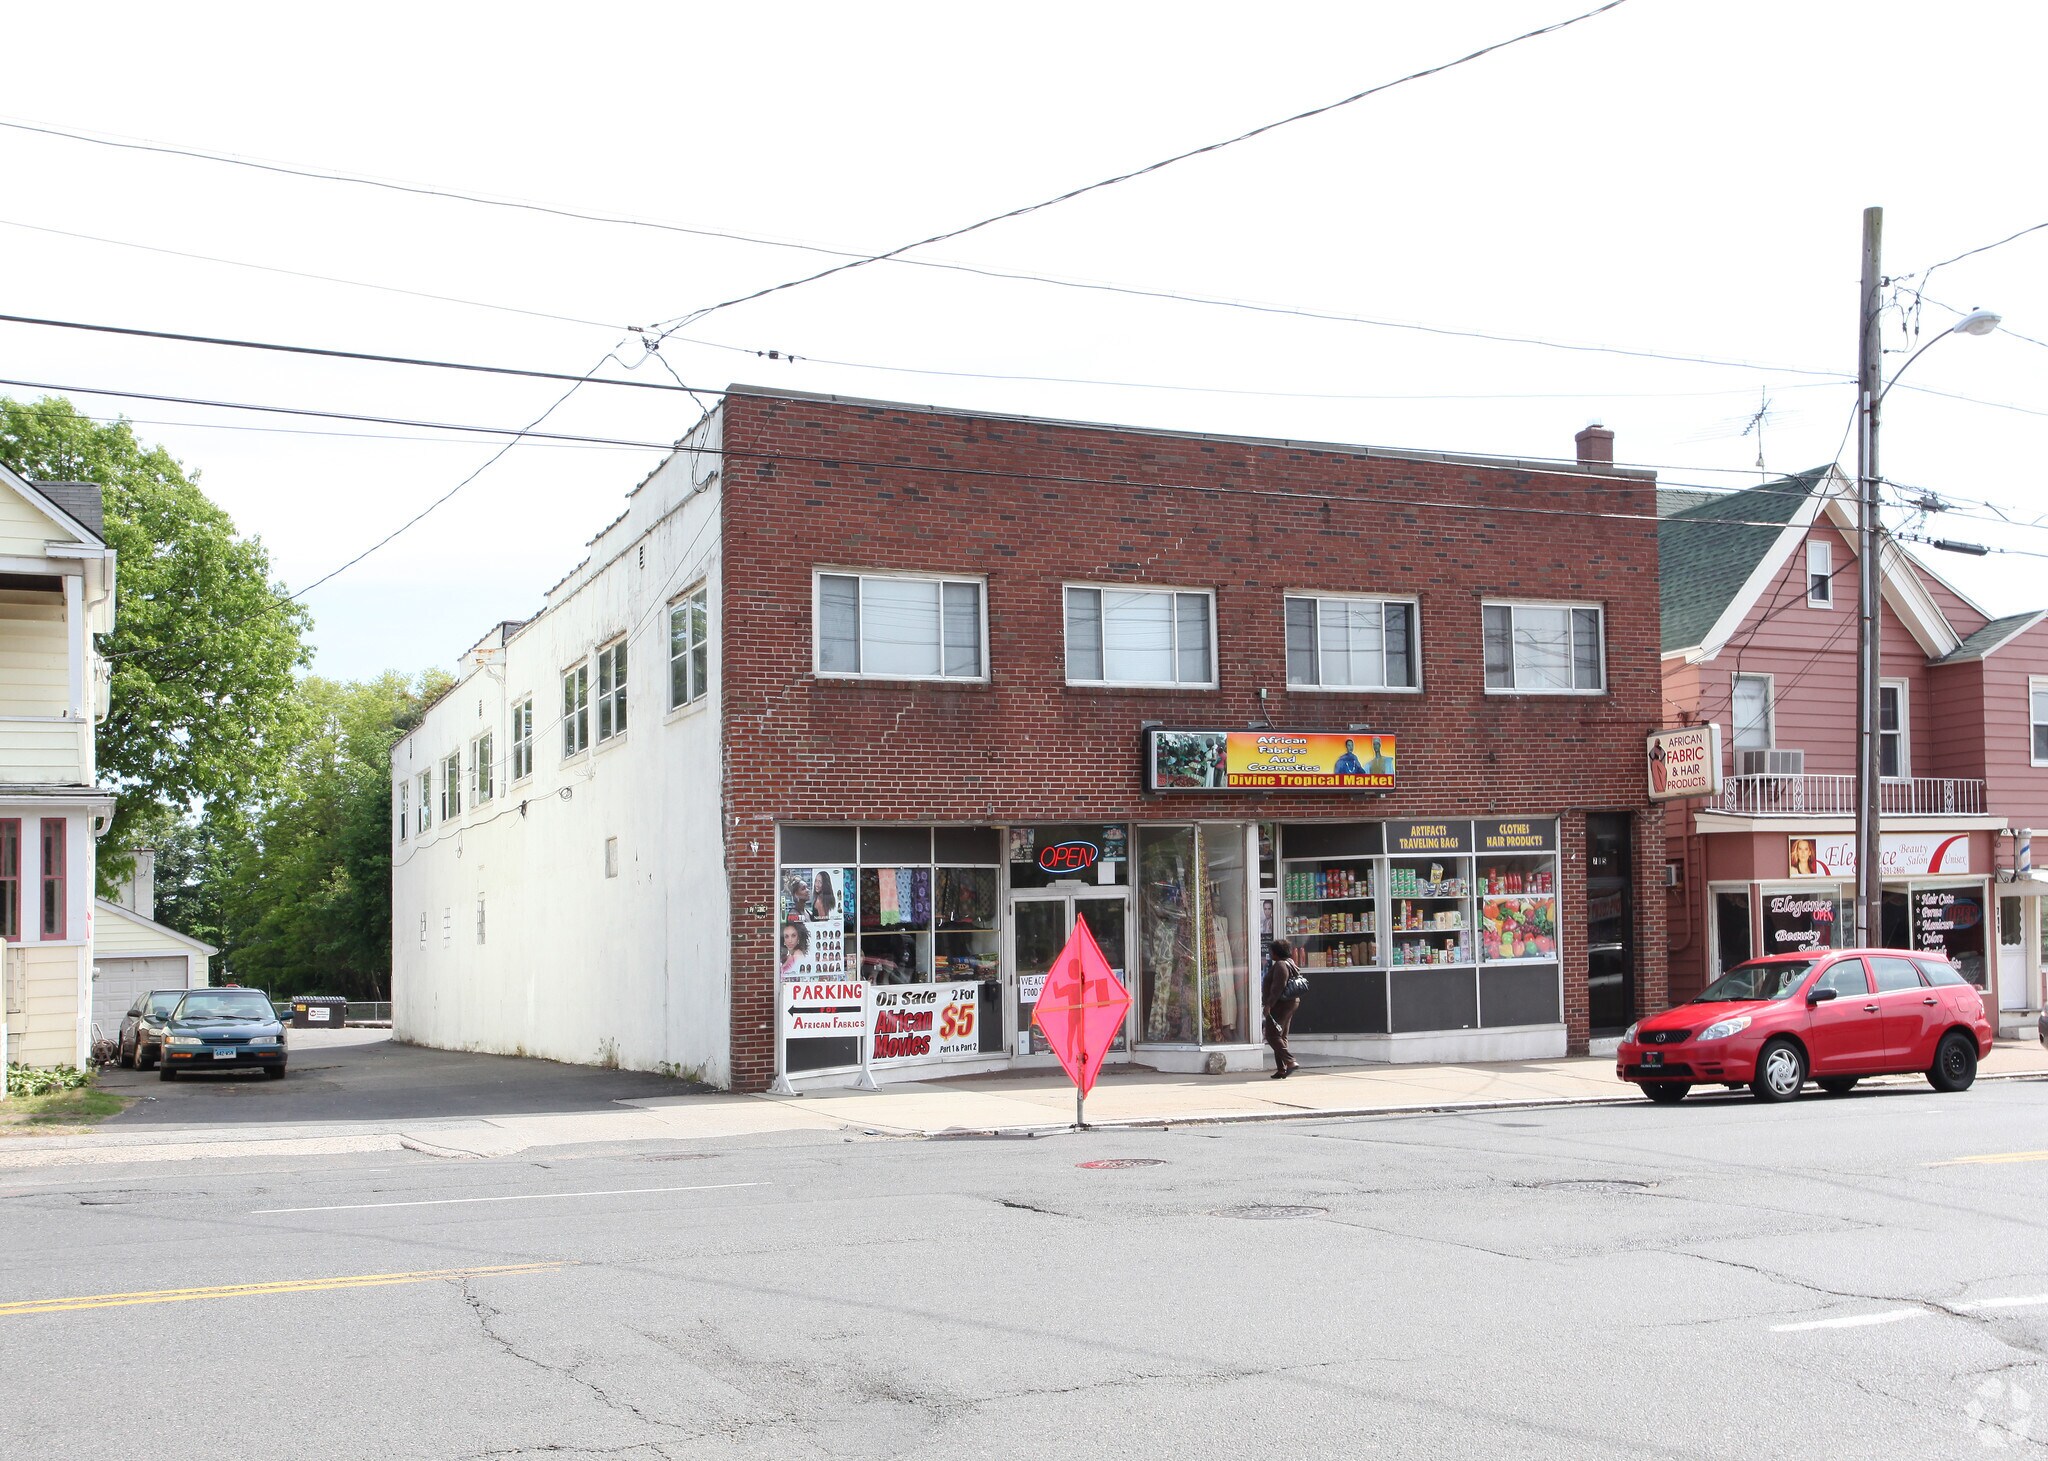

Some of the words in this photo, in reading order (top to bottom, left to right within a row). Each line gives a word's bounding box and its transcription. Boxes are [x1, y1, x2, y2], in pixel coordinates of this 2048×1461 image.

[1257, 736, 1307, 745] African
[1669, 734, 1703, 747] AFRICAN
[1258, 746, 1307, 754] Fabrics
[1667, 746, 1705, 764] FABRIC
[1269, 755, 1297, 763] And
[1247, 763, 1321, 772] Cosmetics
[1672, 767, 1678, 777] &
[1680, 764, 1700, 776] HAIR
[1229, 774, 1276, 785] Divine
[1279, 774, 1340, 786] Tropical
[1343, 775, 1393, 785] Market
[1667, 777, 1706, 790] PRODUCTS
[1411, 825, 1447, 837] ARTIFACTS
[1499, 824, 1530, 835] CLOTHES
[1400, 838, 1439, 849] TRAVELING
[1440, 838, 1459, 848] BAGS
[1486, 836, 1505, 847] HAIR
[1506, 836, 1543, 847] PRODUCTS
[1899, 844, 1928, 856] Beauty
[1040, 846, 1094, 867] OPEN
[1825, 843, 1897, 874] Elece
[1906, 855, 1928, 866] Salon
[1944, 853, 1967, 865] Unisex
[1921, 893, 1938, 905] Hair
[1939, 893, 1954, 905] Cuts
[1771, 895, 1832, 918] Elegance
[1921, 906, 1943, 918] Perms
[1813, 910, 1834, 922] OPEN
[1922, 919, 1954, 931] Manicure
[1775, 929, 1821, 945] Beauty
[1922, 931, 1944, 945] Colors
[1021, 977, 1033, 986] WE
[1034, 976, 1047, 986] ACC
[793, 984, 862, 1000] PARKING
[952, 989, 959, 1001] 2
[959, 989, 975, 1001] For
[1023, 988, 1039, 997] FOOD
[876, 991, 898, 1007] On
[901, 991, 937, 1006] Sale
[820, 1006, 837, 1014] FOR
[793, 1017, 831, 1029] AFRICAN
[833, 1016, 865, 1029] FABRICS
[874, 1009, 934, 1035] African
[939, 1002, 976, 1042] $5
[872, 1033, 932, 1060] Movies
[940, 1045, 951, 1054] Part
[961, 1044, 972, 1052] Part
[973, 1043, 977, 1051] 2
